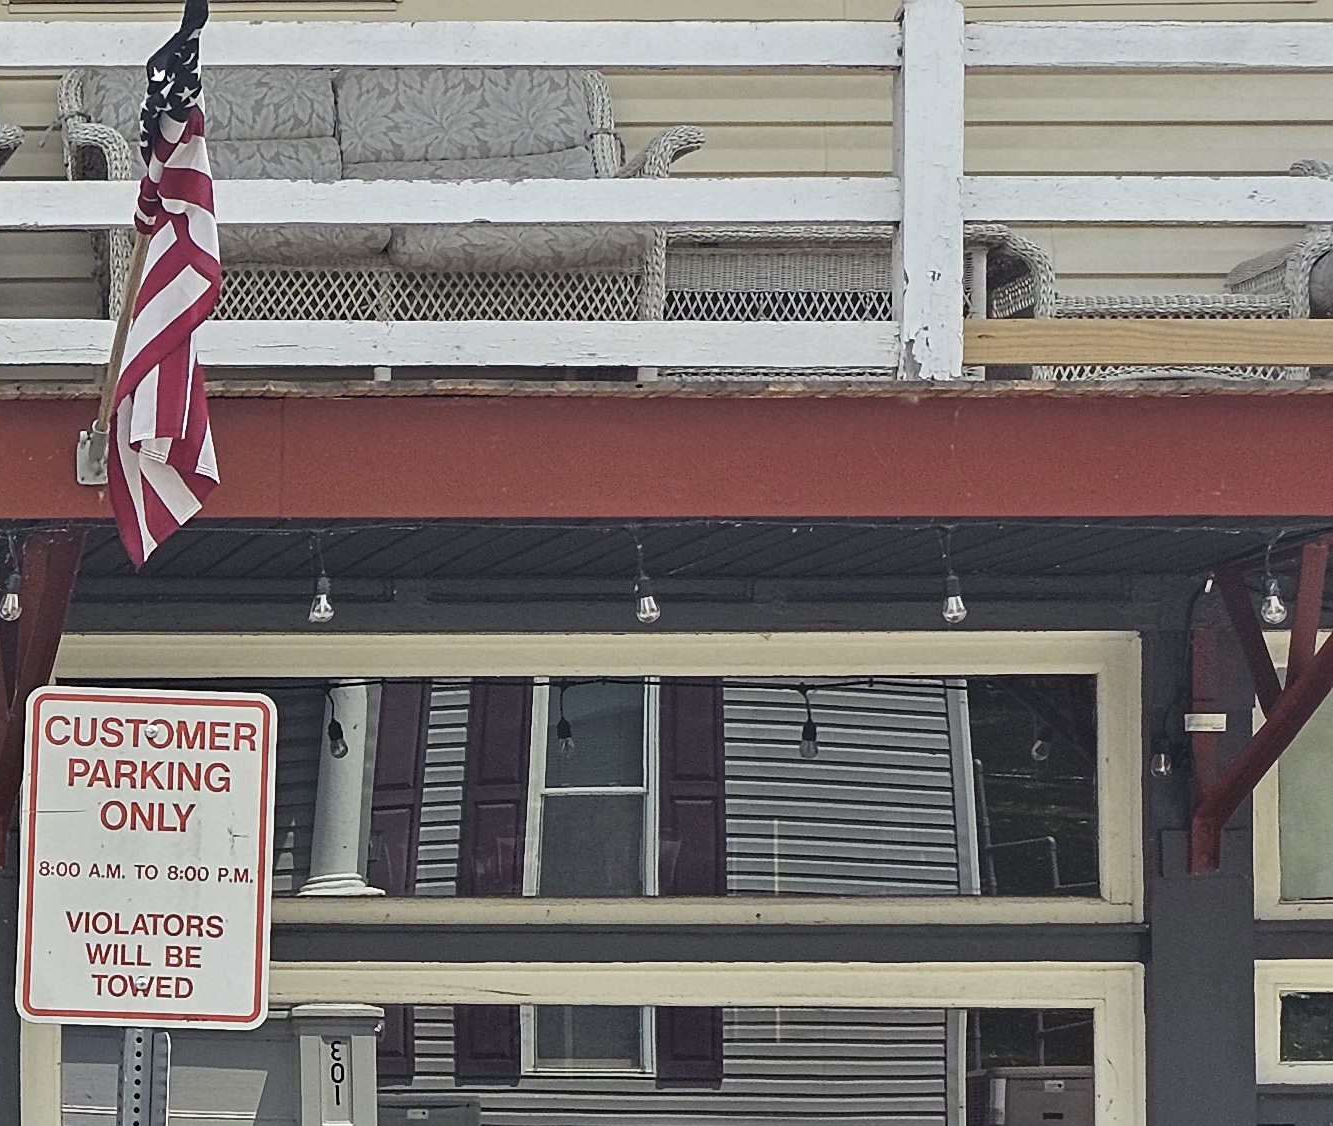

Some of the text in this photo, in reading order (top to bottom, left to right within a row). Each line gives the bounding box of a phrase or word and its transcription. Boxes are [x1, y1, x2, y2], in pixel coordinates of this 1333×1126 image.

[44, 716, 256, 751] CUSTOMER
[67, 758, 230, 792] PARKING
[100, 800, 195, 832] ONLY
[38, 861, 254, 884] 8:00 A.M. TO 8:00 P.M.
[65, 911, 224, 939] VIOLATORS
[85, 943, 202, 968] WILL BE
[91, 974, 194, 999] TOWED
